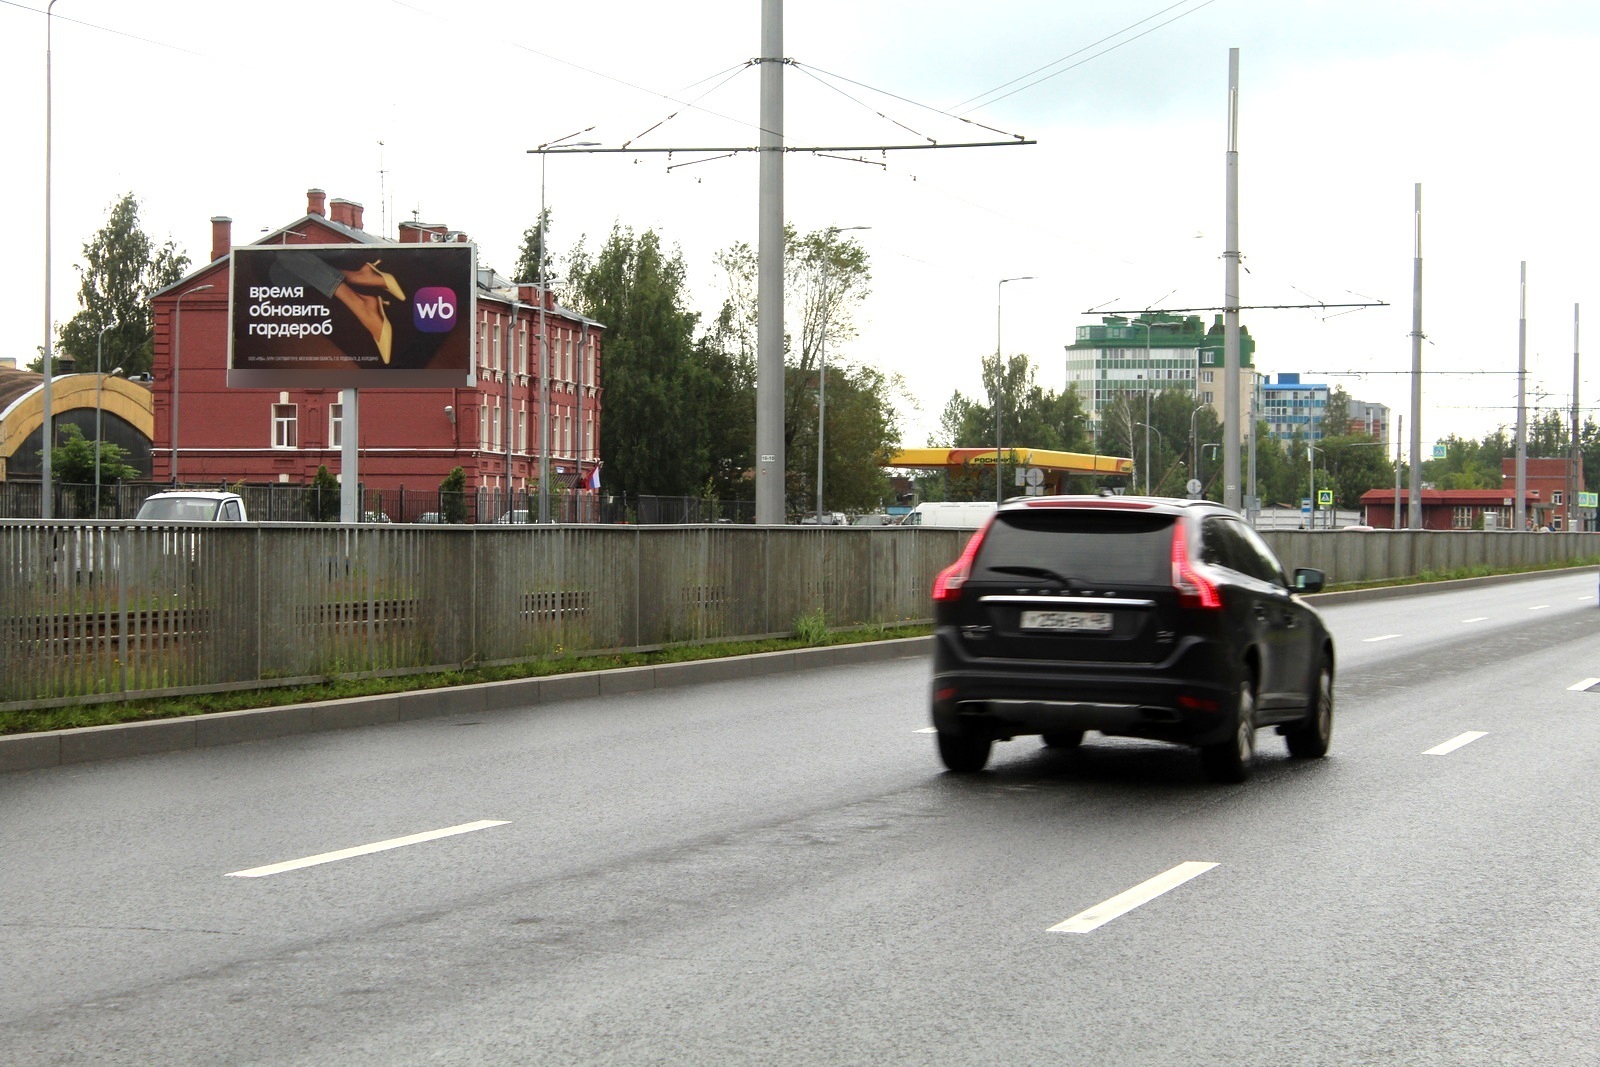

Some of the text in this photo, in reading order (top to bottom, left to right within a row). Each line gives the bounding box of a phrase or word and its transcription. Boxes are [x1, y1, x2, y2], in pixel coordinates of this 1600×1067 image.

[249, 286, 304, 302] время
[249, 300, 331, 317] обновить
[416, 296, 454, 319] wb
[249, 319, 333, 339] гардероб
